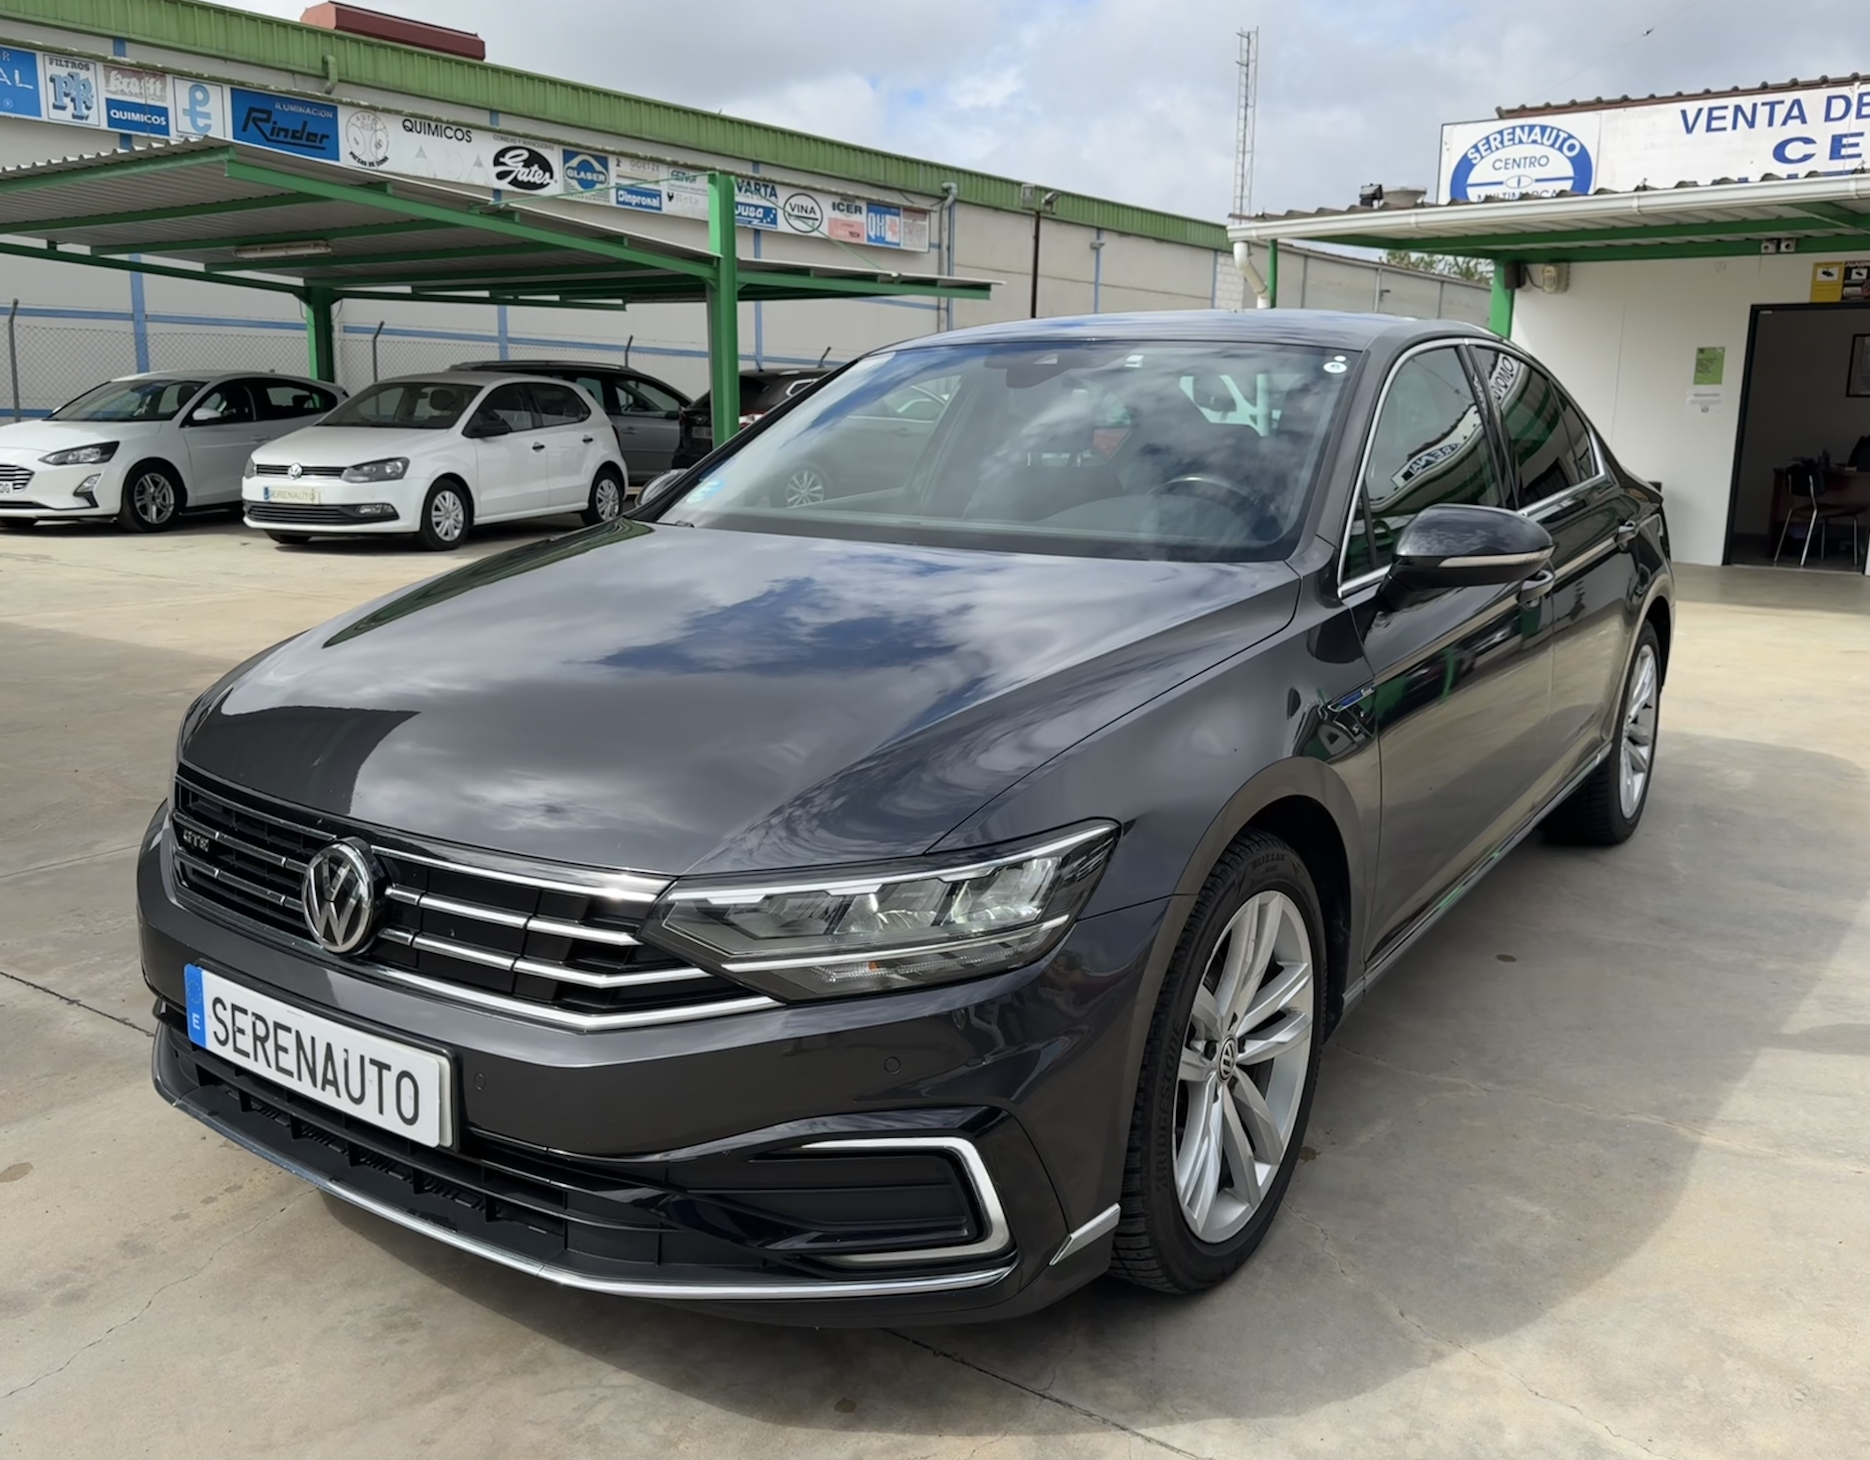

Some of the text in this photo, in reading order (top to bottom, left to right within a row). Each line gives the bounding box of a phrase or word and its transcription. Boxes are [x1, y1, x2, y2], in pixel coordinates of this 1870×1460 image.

[48, 57, 91, 71] FILTROS
[110, 109, 167, 126] QUIMICOS
[1680, 91, 1870, 135] VENTA DE
[241, 106, 331, 150] Rinder
[402, 118, 472, 143] QUIMICOS
[1467, 126, 1581, 164] SERENAUTO
[1772, 132, 1865, 165] CE
[493, 149, 552, 185] Gates
[1492, 155, 1550, 171] CENTRO
[566, 168, 606, 183] GLASER
[736, 179, 778, 199] VARTA
[788, 202, 817, 216] VINA
[831, 202, 863, 215] ICER
[868, 212, 886, 240] QH
[192, 1012, 201, 1030] E
[212, 996, 420, 1127] SERENAUTO
